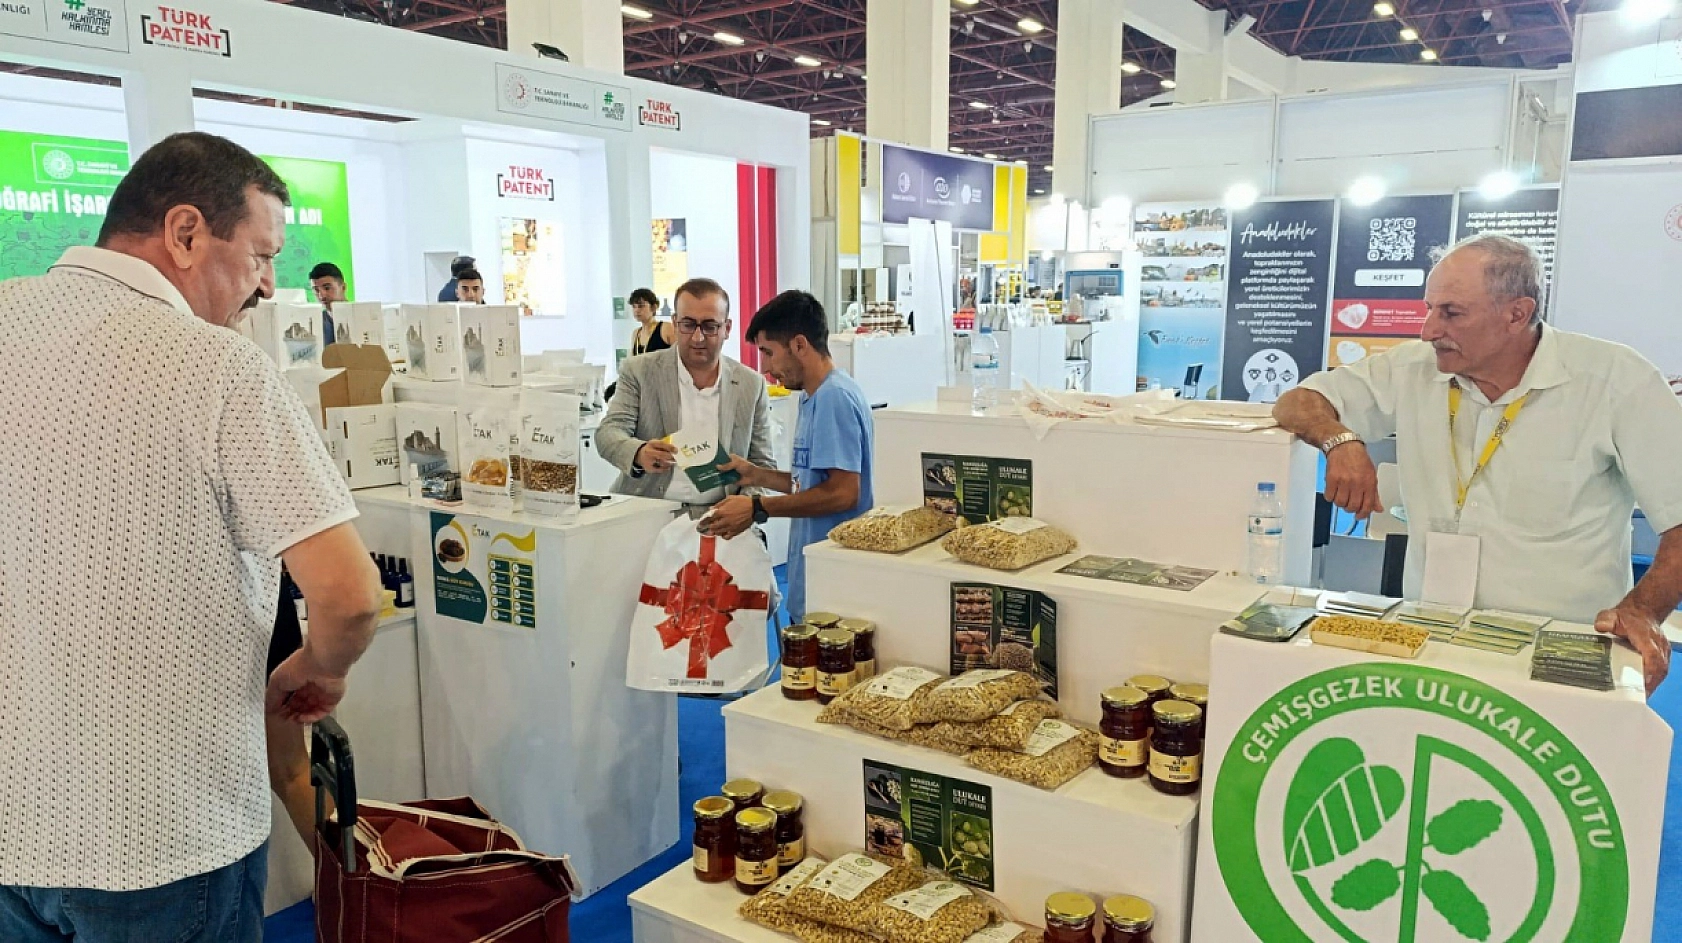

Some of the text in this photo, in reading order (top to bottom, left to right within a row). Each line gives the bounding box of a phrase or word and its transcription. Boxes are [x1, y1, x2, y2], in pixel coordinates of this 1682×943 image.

[0, 3, 31, 15] NLIĞI
[158, 6, 212, 30] TÜRK
[149, 22, 222, 49] PATENT
[646, 98, 672, 113] TÜRK
[642, 110, 677, 126] PATENT
[508, 165, 543, 181] TÜRK
[503, 179, 550, 196] PATENT
[63, 188, 112, 218] İŞAR
[1373, 273, 1404, 282] KEŞFET
[1242, 675, 1615, 849] ÇEMİŞGEZEK ULUKALE DUTU
[952, 788, 987, 803] ULUKALE
